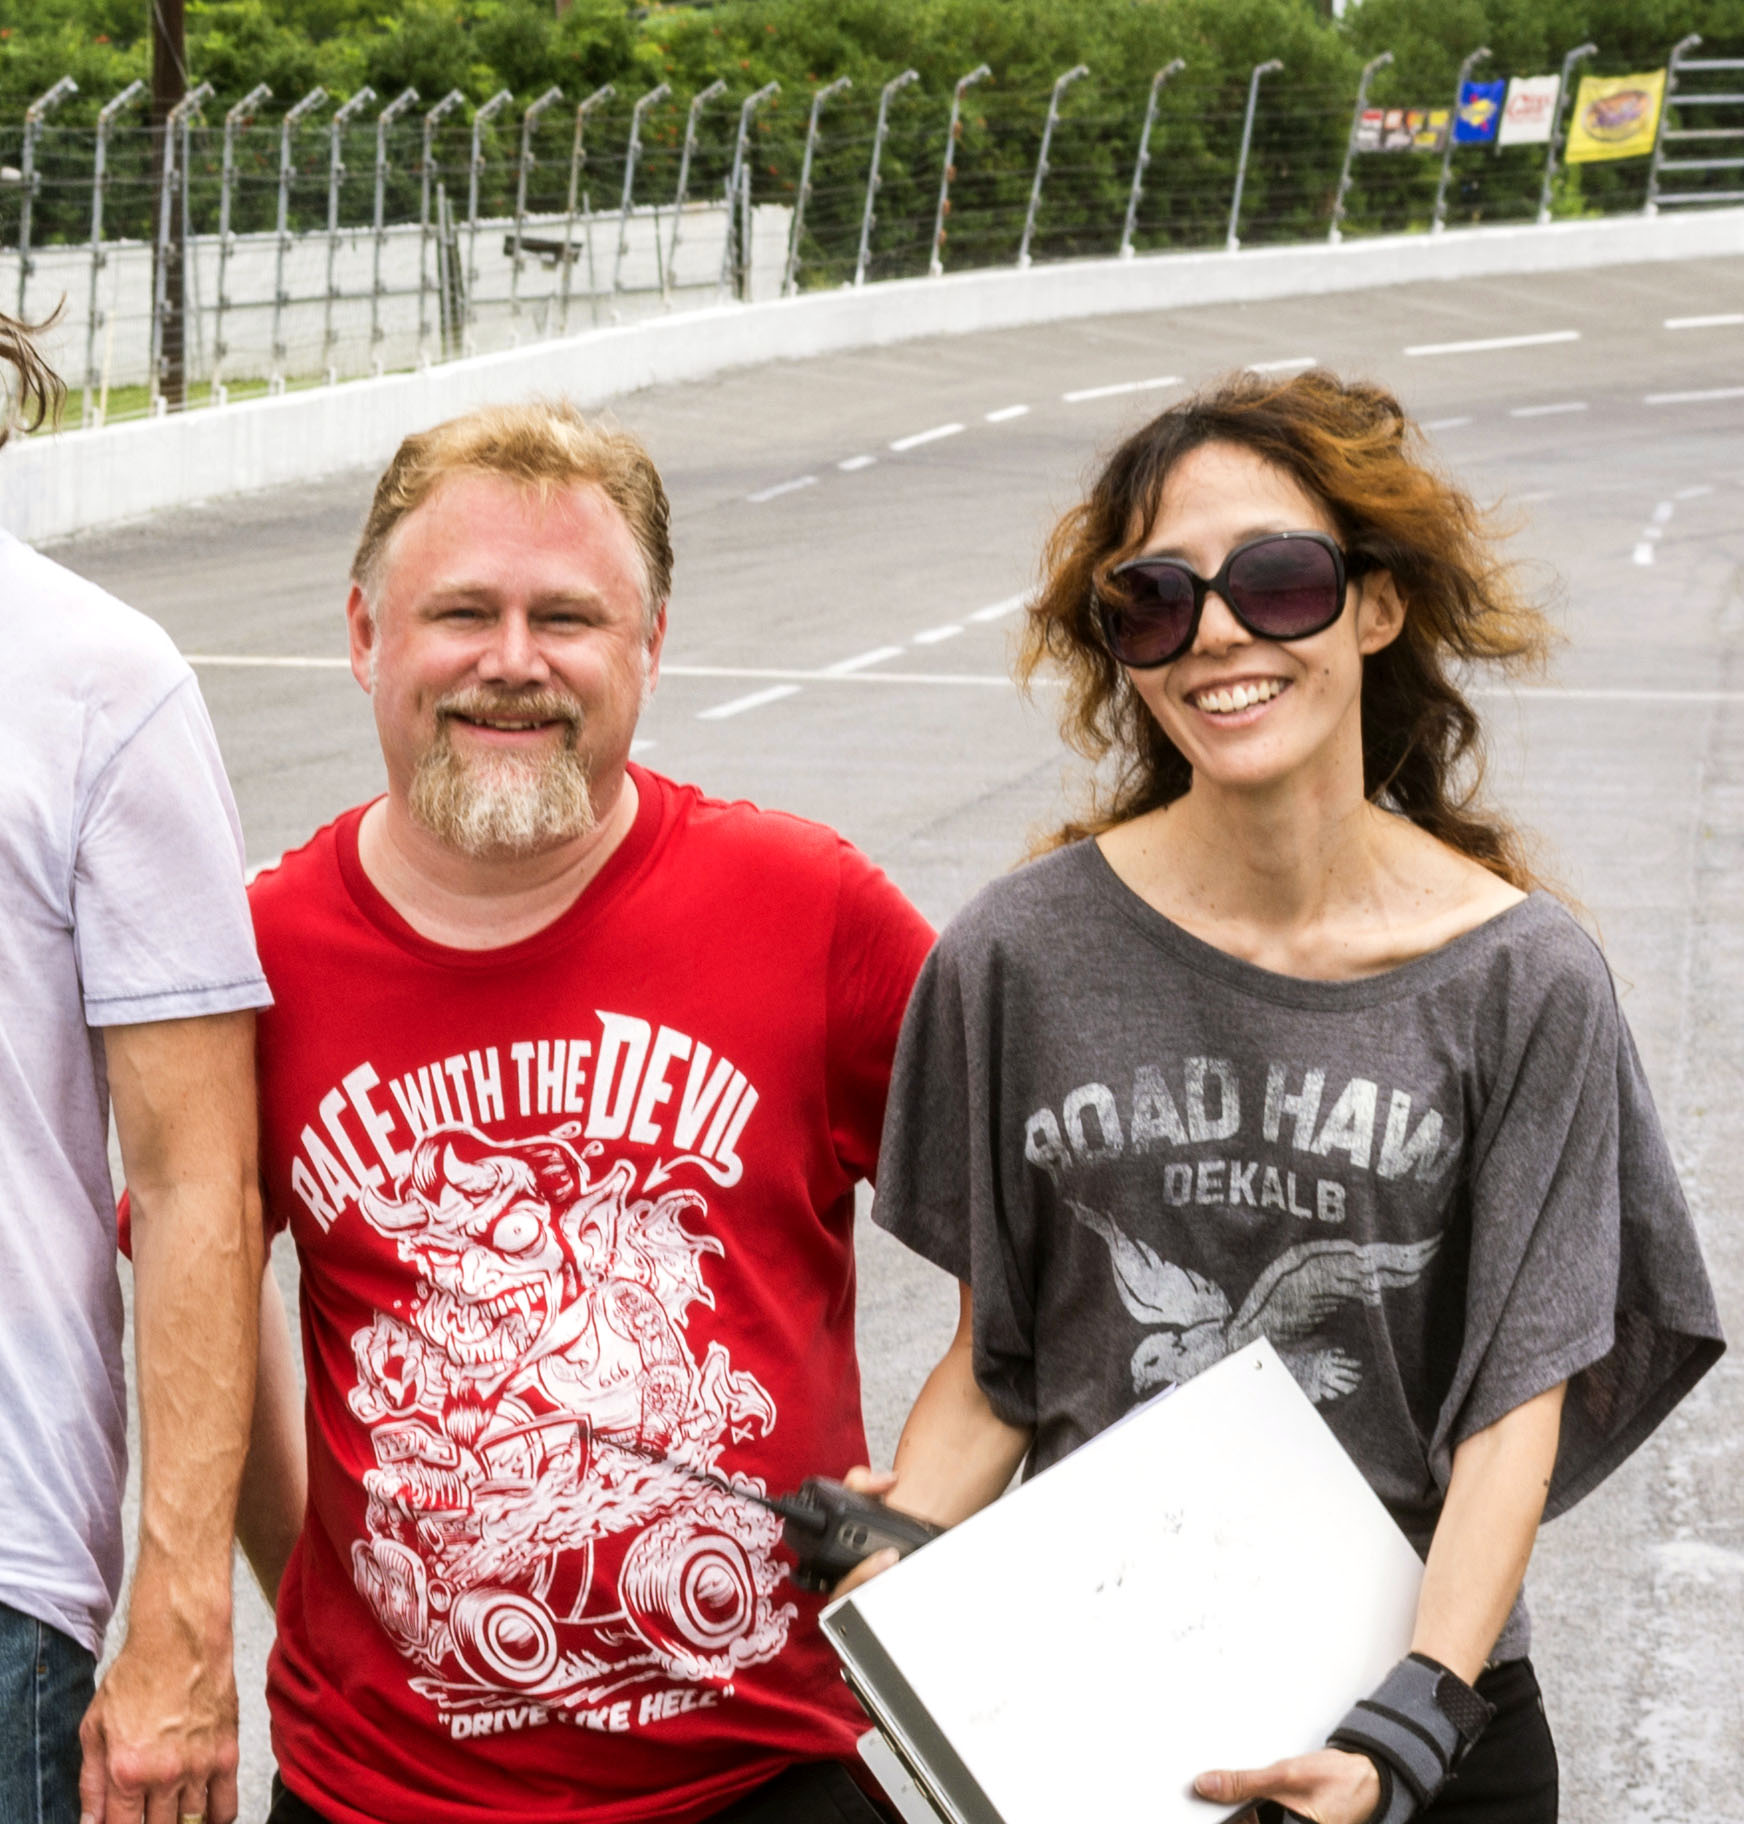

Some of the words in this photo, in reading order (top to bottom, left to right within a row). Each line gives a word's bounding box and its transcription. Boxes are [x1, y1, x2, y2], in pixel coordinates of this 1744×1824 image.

[292, 1061, 411, 1235] RACE
[389, 1046, 505, 1142] WITH
[510, 1039, 592, 1117] THE
[583, 1009, 760, 1189] DEVIL
[1163, 1159, 1348, 1224] DEKALB
